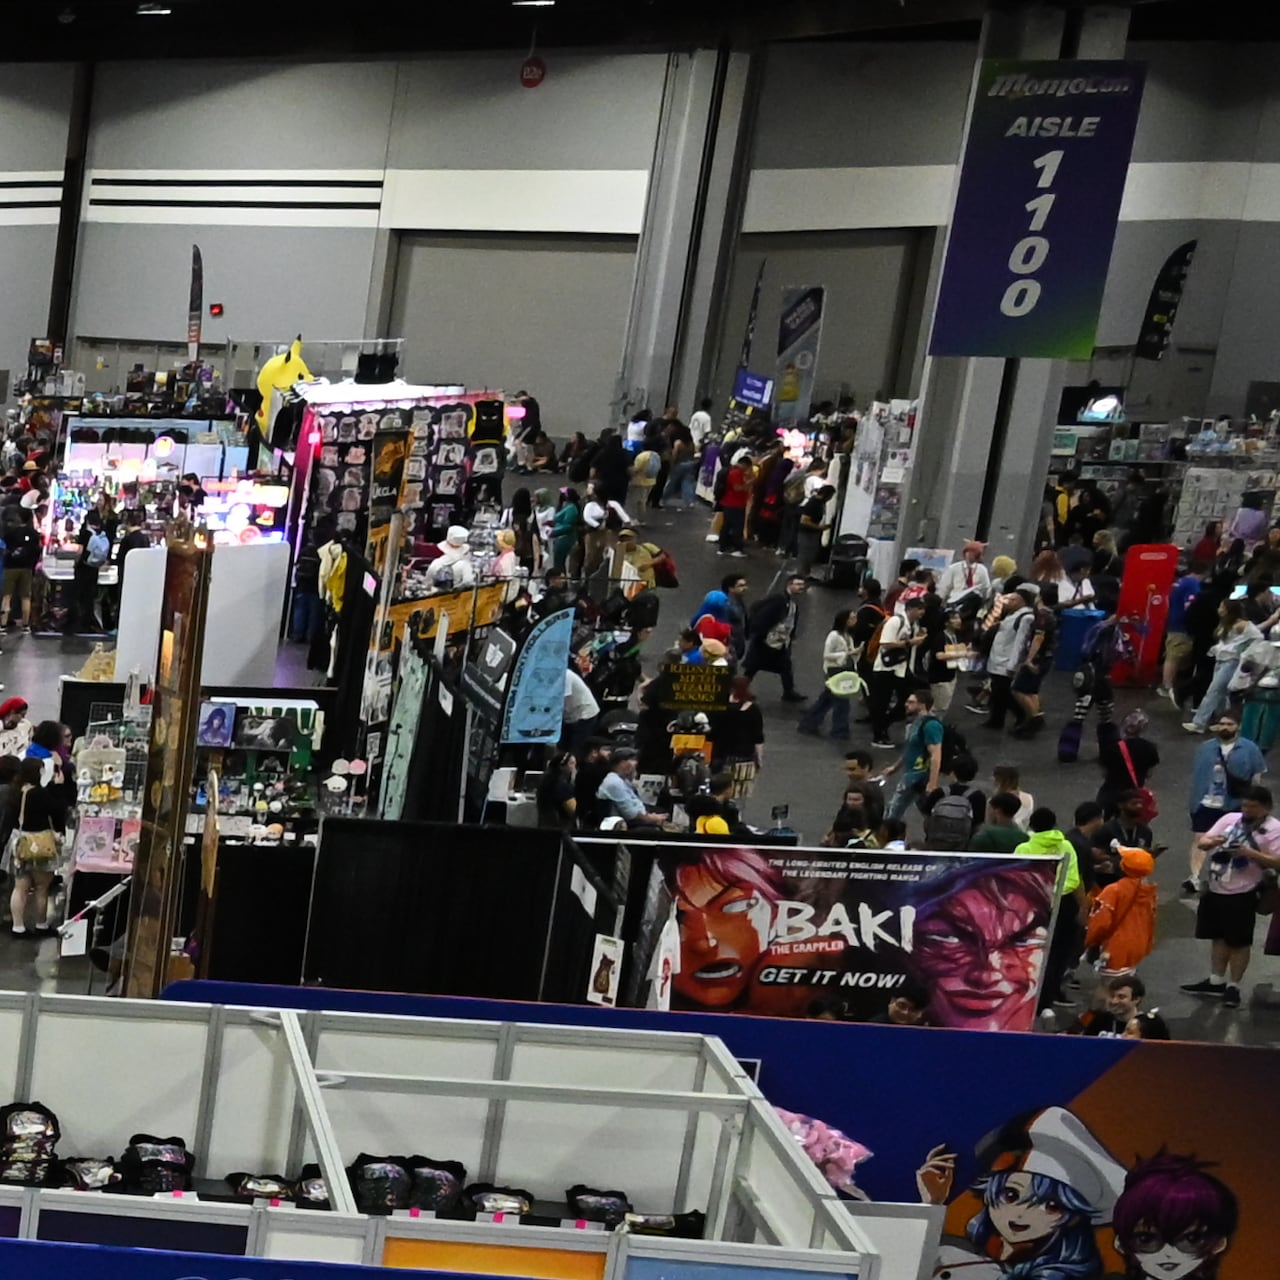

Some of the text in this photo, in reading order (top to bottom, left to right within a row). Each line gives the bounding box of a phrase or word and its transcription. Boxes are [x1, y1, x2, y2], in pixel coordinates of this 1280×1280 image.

[1005, 116, 1101, 137] AISLE
[999, 150, 1065, 317] 1100
[769, 899, 916, 953] BAKI
[770, 940, 844, 955] THE GRAPPLER
[759, 967, 906, 988] GET IT NOW!
